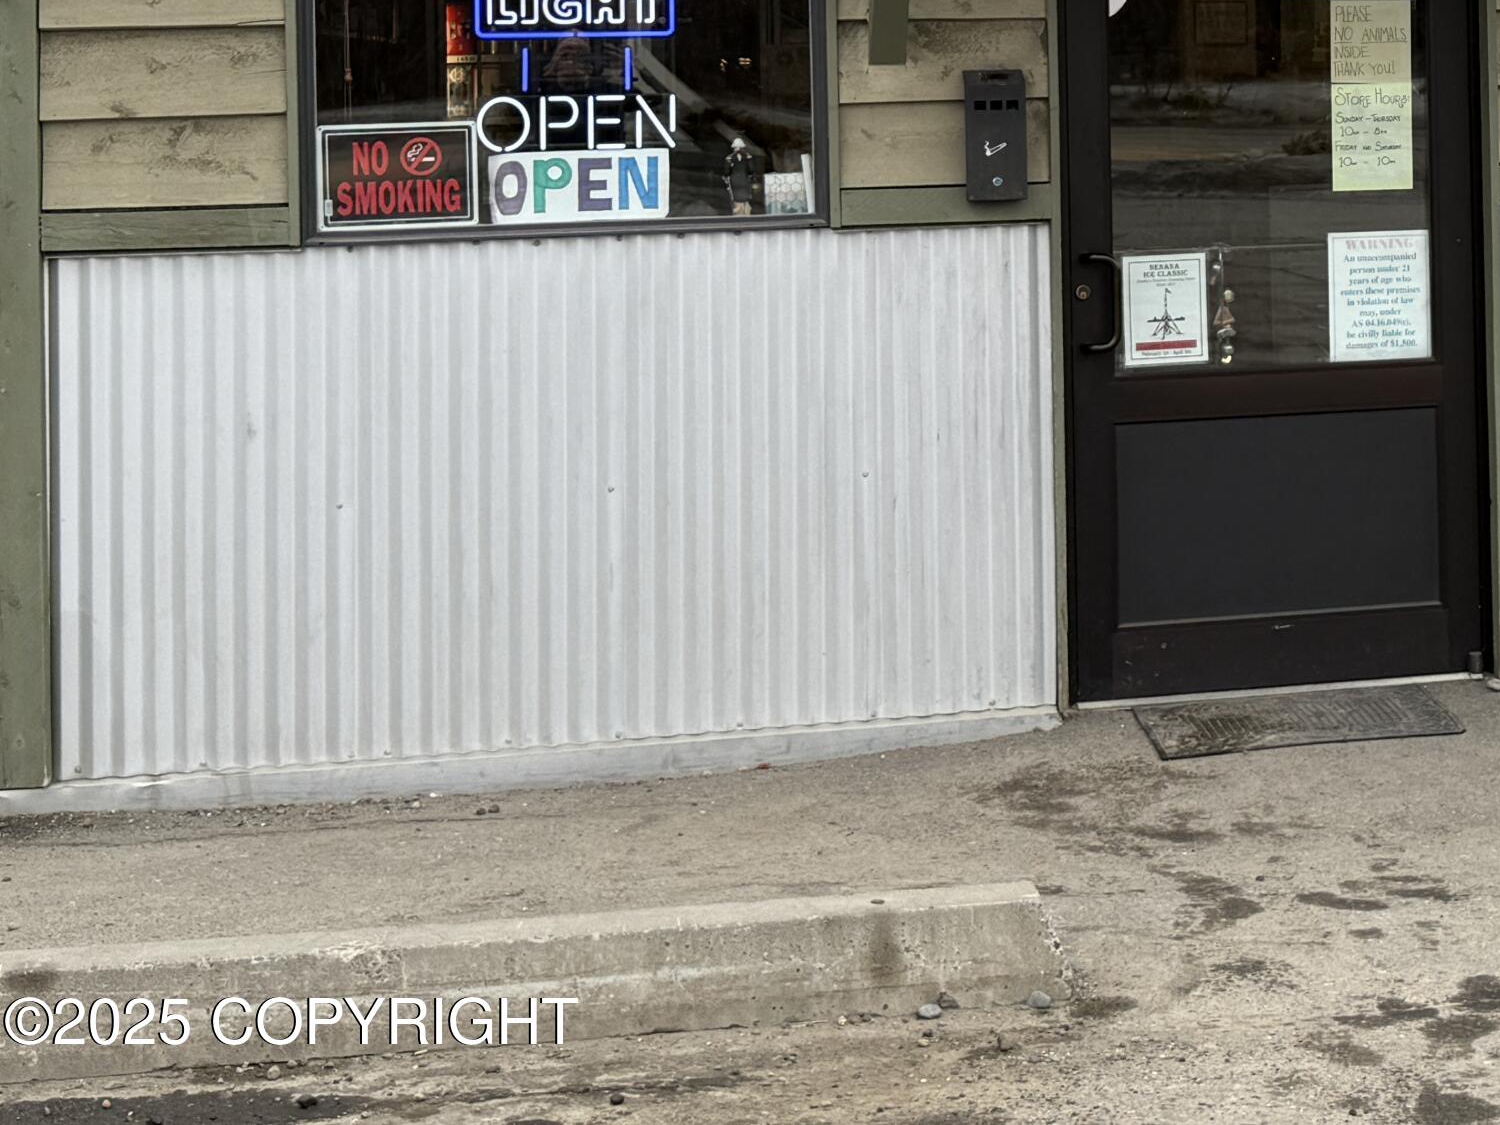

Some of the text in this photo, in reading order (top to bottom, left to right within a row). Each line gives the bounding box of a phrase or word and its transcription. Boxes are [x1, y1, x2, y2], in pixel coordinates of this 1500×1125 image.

[1335, 5, 1373, 22] PLEASE
[1334, 26, 1408, 43] NO ANIMALS
[1334, 60, 1365, 77] THANK
[477, 94, 676, 152] OPEN
[352, 141, 389, 176] NO
[494, 156, 659, 215] OPEN
[337, 178, 461, 216] SMOKING
[1345, 238, 1413, 250] WARNING
[1344, 254, 1355, 262] An
[1349, 266, 1375, 275] person
[1349, 278, 1369, 286] years
[1371, 276, 1379, 284] of
[1365, 286, 1384, 295] these
[1386, 286, 1420, 296] premises
[1347, 298, 1355, 306] in
[1357, 297, 1389, 306] violation
[1379, 308, 1401, 316] under
[1358, 330, 1379, 339] civilly
[1405, 328, 1415, 336] for
[1381, 339, 1389, 347] of
